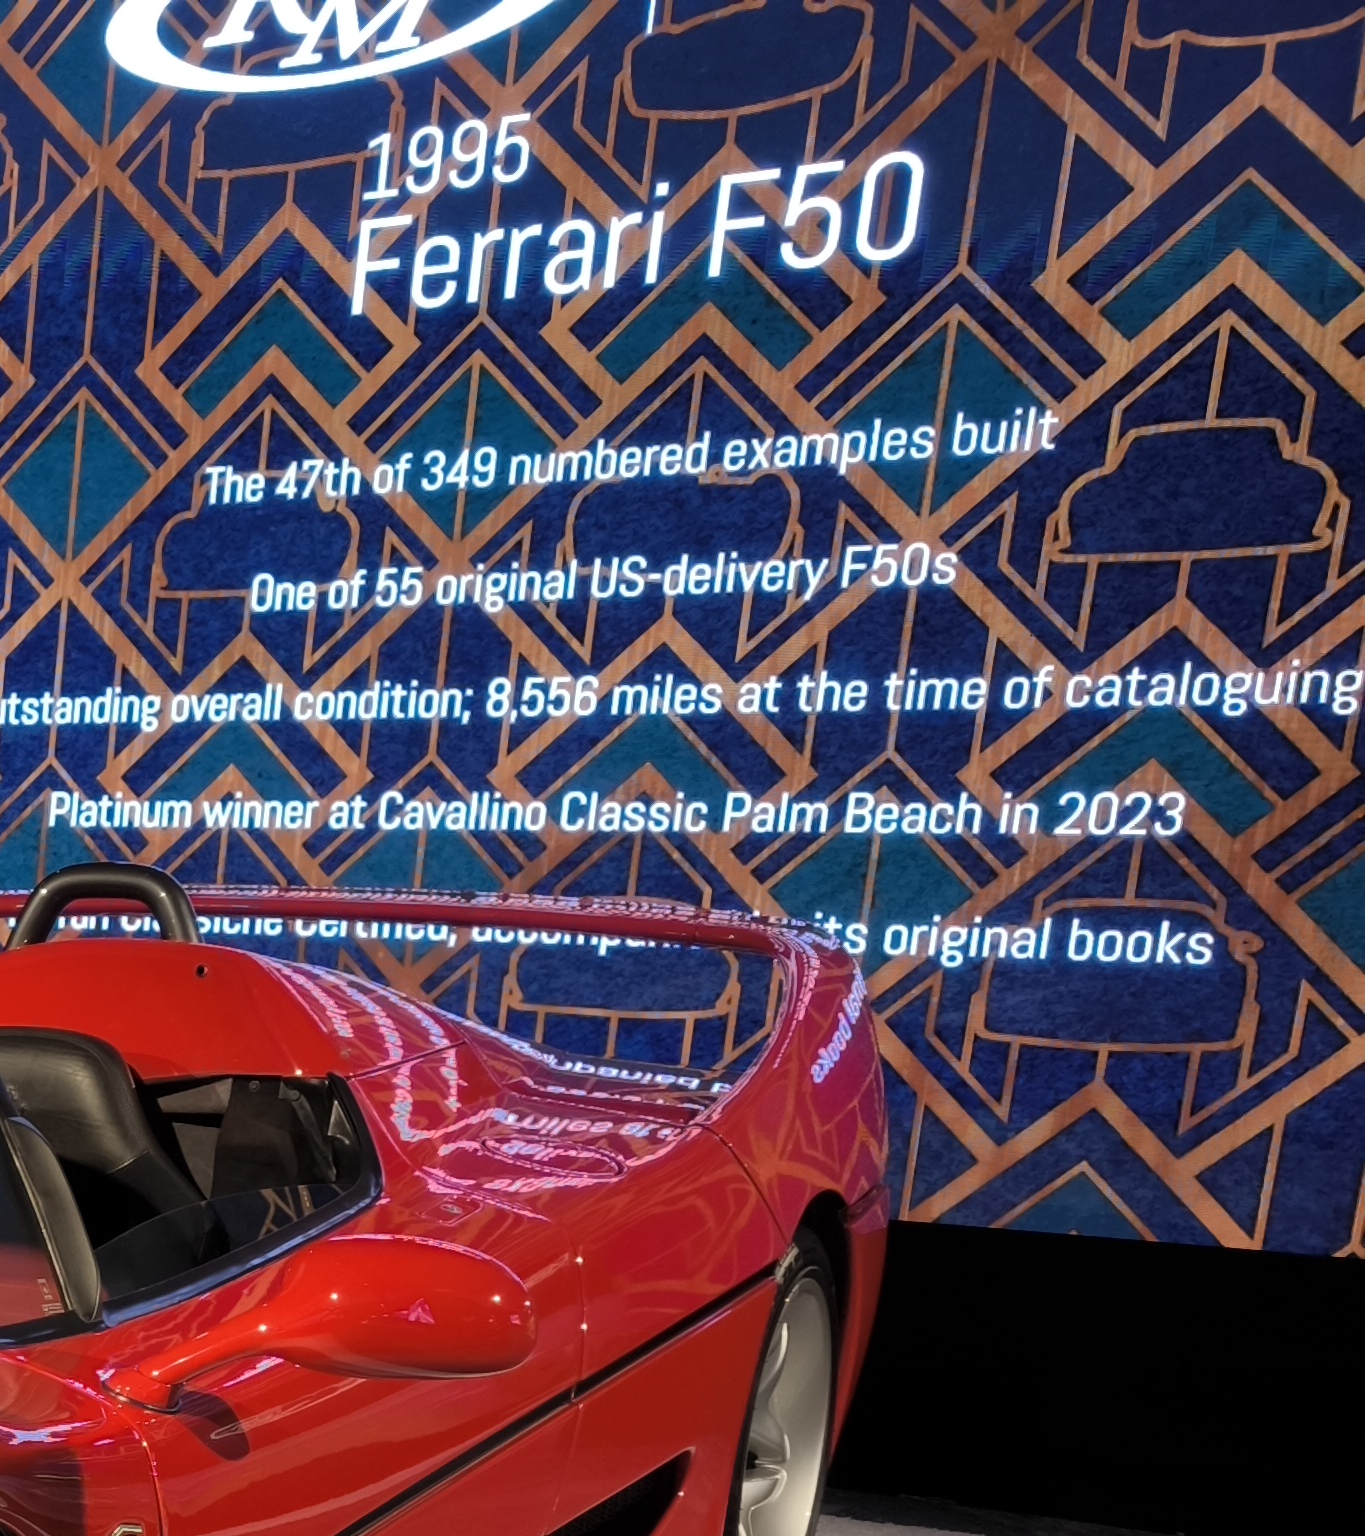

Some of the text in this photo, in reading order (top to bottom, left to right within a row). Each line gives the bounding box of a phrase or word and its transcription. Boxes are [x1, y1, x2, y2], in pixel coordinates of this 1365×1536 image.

[363, 113, 531, 200] 1995
[352, 151, 924, 315] Ferrari F50
[205, 407, 1060, 505] The 47th of 349 numbered examples built
[250, 542, 959, 614] One of 55 original US-delivery F50s
[170, 683, 283, 724] overall
[294, 680, 473, 725] condition;
[487, 675, 599, 725] 8,556
[612, 675, 723, 715] miles
[738, 676, 781, 715] at
[798, 671, 867, 712] the
[885, 669, 987, 711] time
[1005, 665, 1055, 709] of
[1066, 660, 1363, 716] cataloguing
[49, 791, 1186, 836] Platinum winner at Cavallino Classic Palm Beach in 2023
[883, 916, 1051, 968] original
[1069, 919, 1214, 965] books
